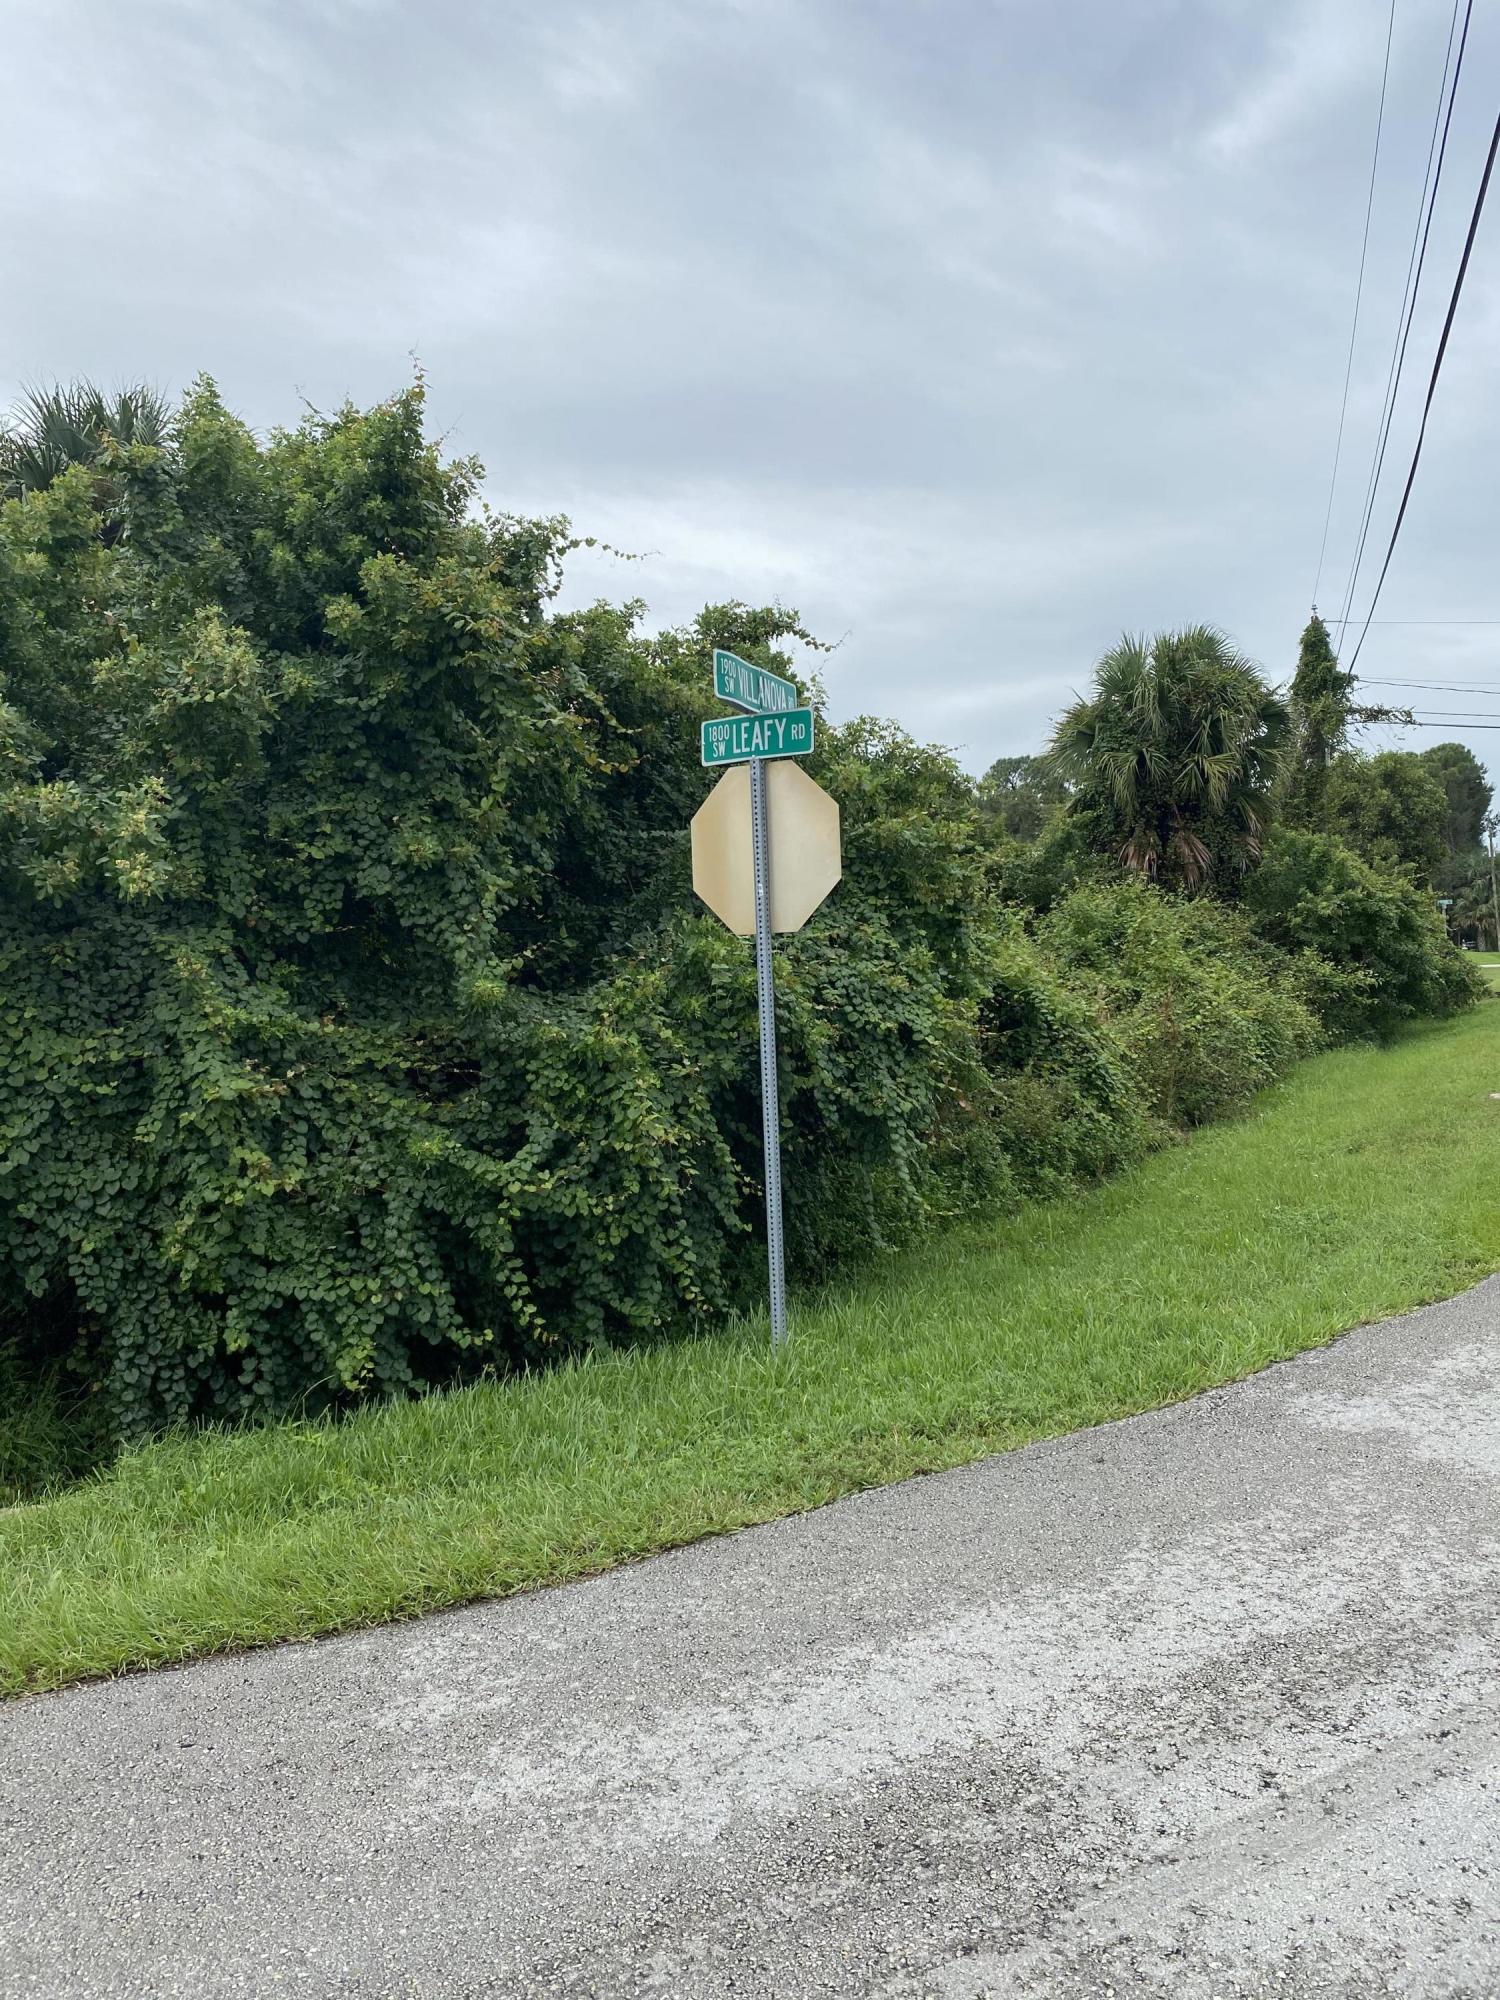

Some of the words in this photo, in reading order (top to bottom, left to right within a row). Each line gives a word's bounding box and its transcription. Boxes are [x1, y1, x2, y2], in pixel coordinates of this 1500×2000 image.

[720, 657, 736, 678] 1900
[724, 675, 735, 694] SW
[738, 665, 786, 711] VILLANOVA
[709, 724, 729, 742] 1800
[733, 717, 787, 754] LEAFY
[791, 723, 805, 740] RD
[713, 741, 726, 758] SW
